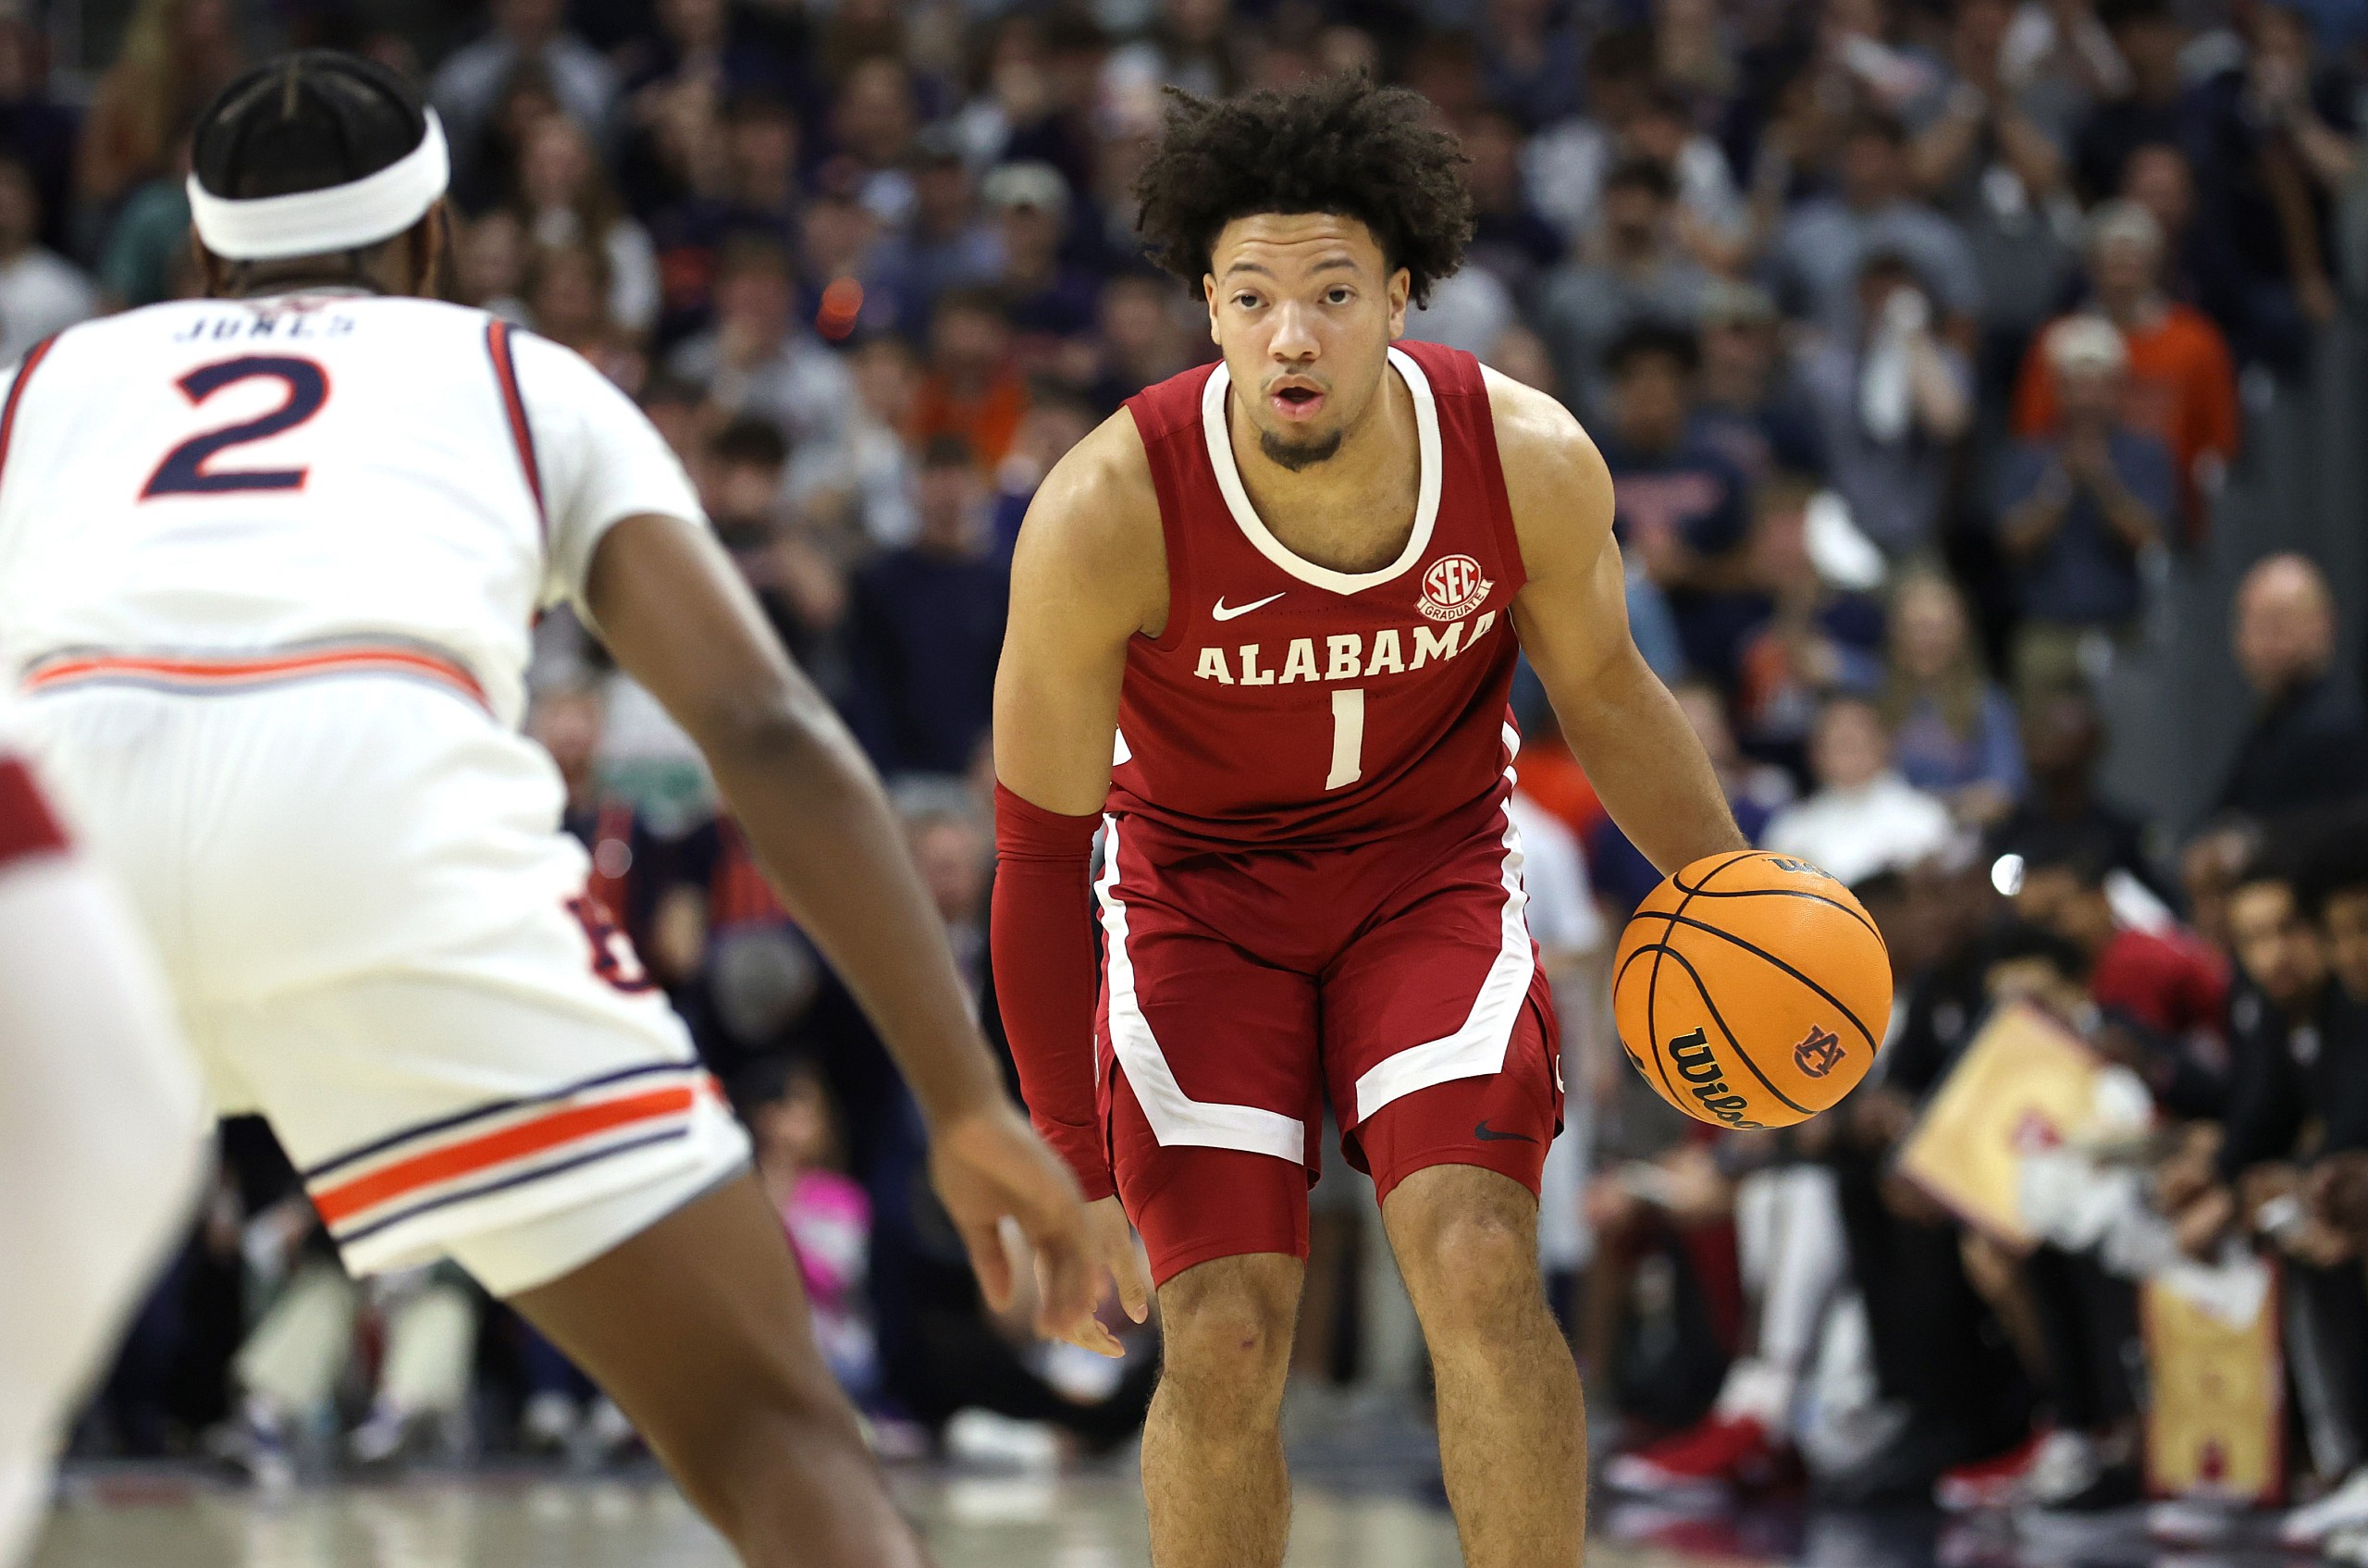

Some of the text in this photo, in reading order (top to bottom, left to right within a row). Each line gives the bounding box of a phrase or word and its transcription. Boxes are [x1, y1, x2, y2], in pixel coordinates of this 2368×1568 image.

[137, 352, 331, 502] 2
[1424, 592, 1486, 621] GRADUATE
[1427, 560, 1476, 605] SEC
[1193, 610, 1497, 685] ALABAMA
[1325, 688, 1364, 791] 1
[1668, 1026, 1770, 1130] Wilso
